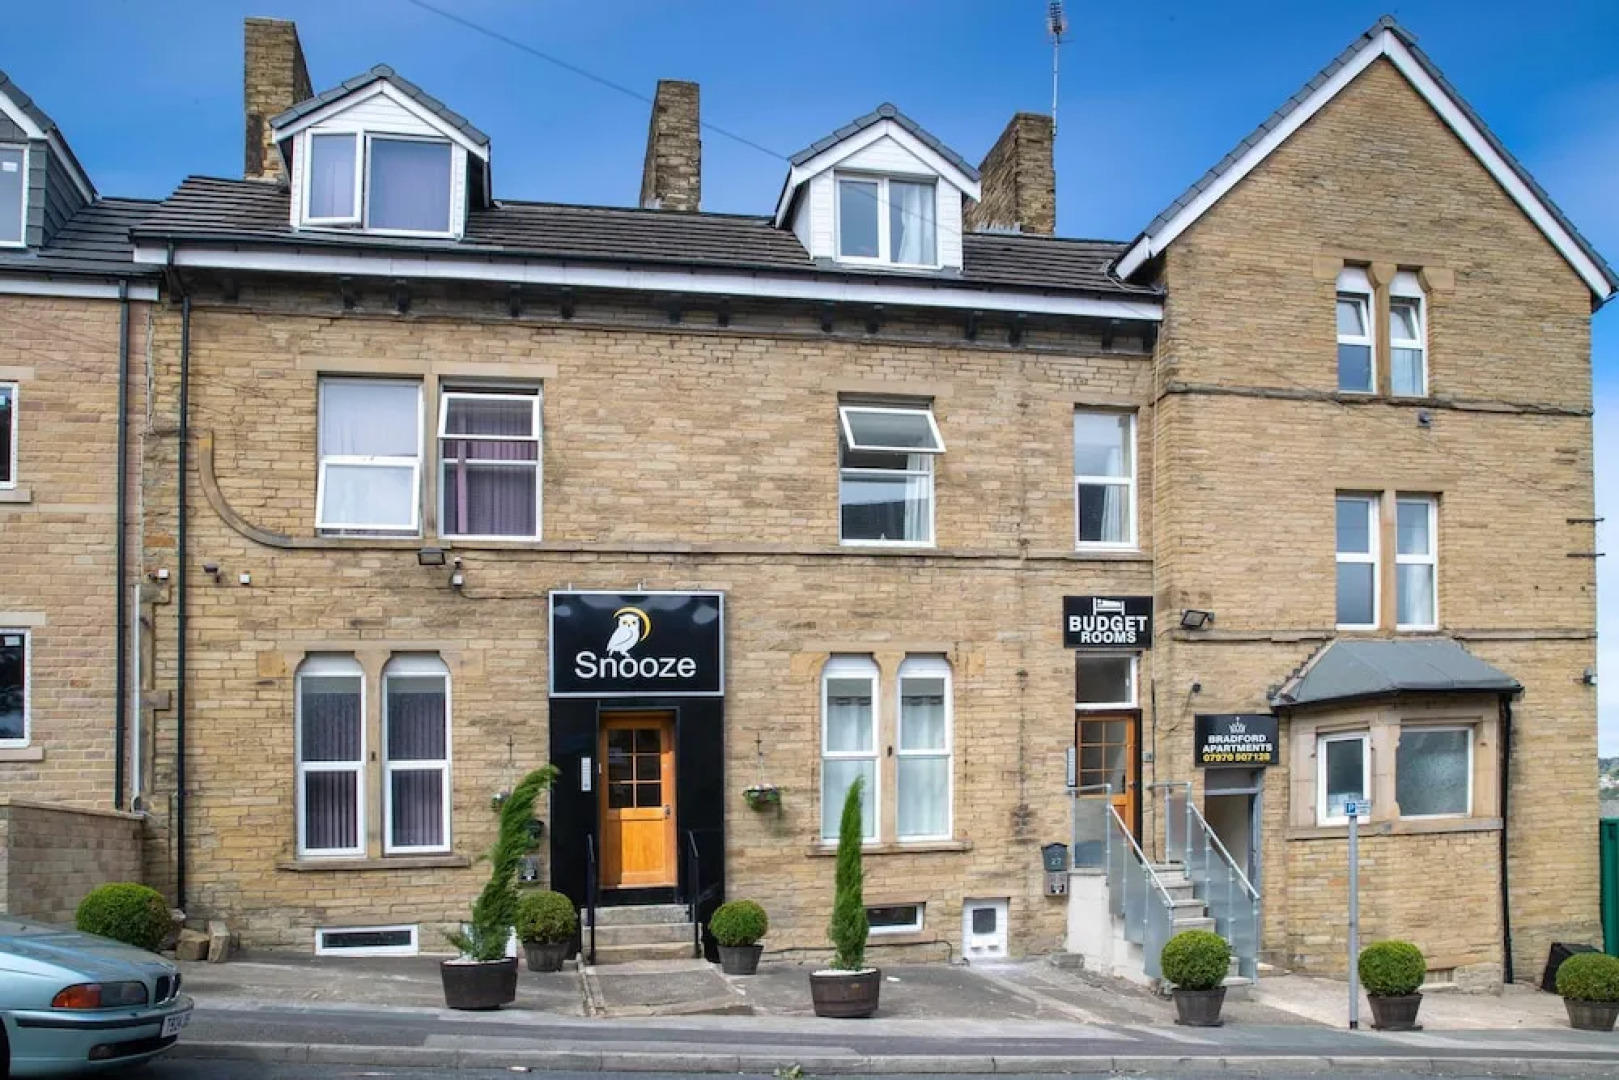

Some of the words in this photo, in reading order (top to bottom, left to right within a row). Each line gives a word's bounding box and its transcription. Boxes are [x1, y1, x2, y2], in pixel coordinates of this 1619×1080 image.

[1068, 615, 1148, 632] BUDGET
[1080, 631, 1137, 644] ROOMS
[574, 651, 697, 678] Snooze
[1208, 734, 1266, 743] BRADFORD
[1202, 743, 1272, 753] APARTMENTS
